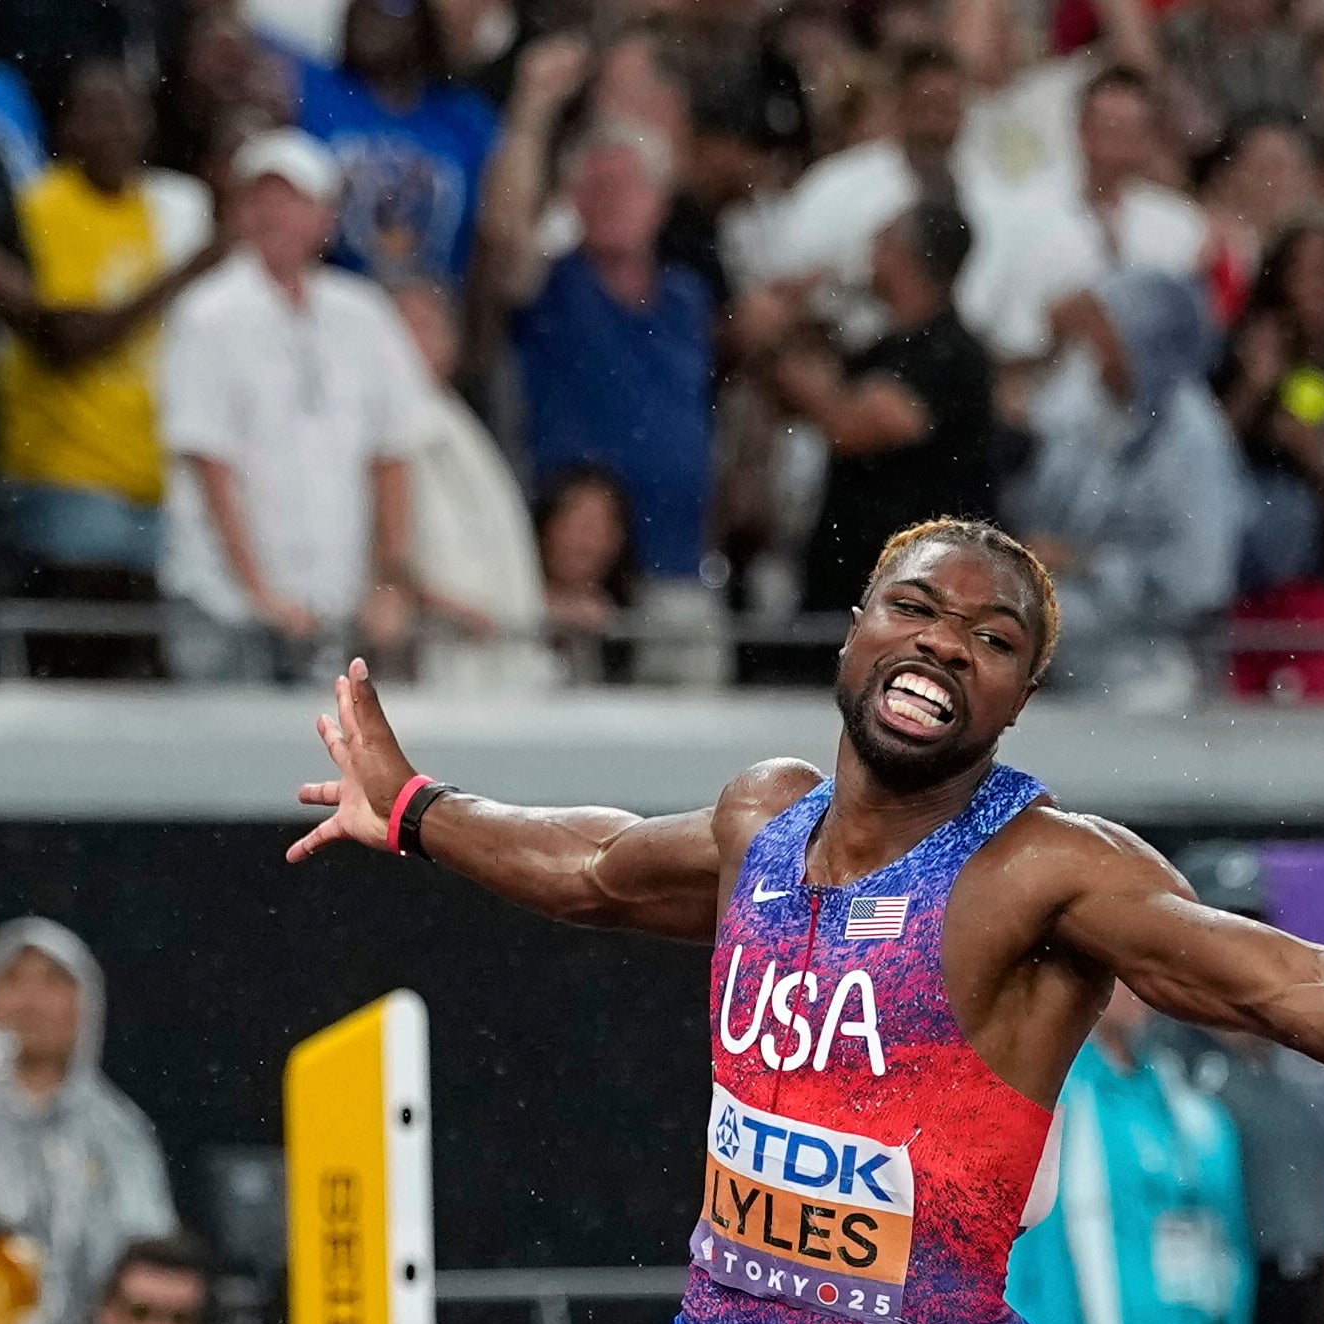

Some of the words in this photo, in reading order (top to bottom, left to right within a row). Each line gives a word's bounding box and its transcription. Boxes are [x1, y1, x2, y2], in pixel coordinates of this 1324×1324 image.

[720, 944, 886, 1077] USA
[742, 1114, 894, 1204] TDK
[711, 1171, 878, 1269] LYLES
